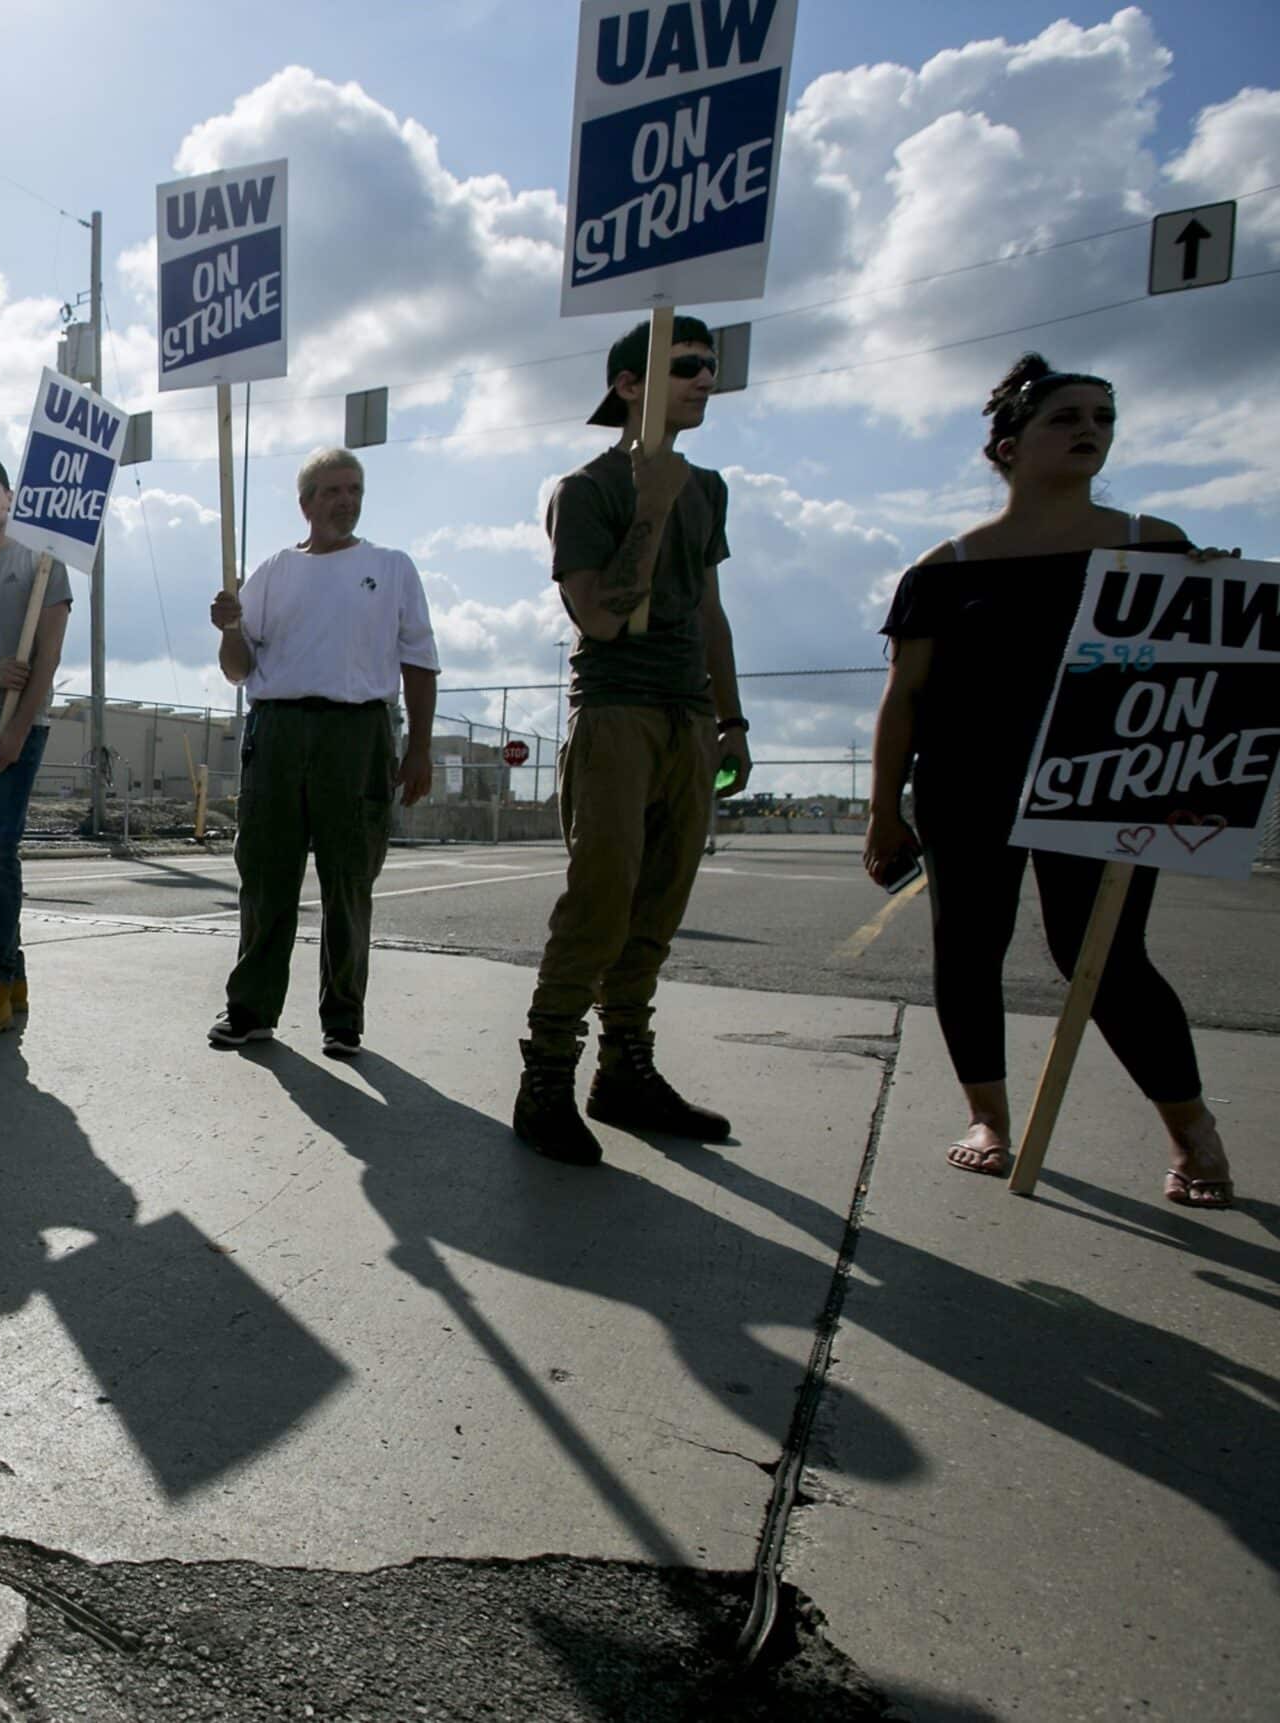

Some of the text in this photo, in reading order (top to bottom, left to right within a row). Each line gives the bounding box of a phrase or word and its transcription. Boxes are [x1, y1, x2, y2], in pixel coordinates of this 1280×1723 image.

[596, 0, 778, 85] UAW
[631, 95, 711, 184] ON
[166, 175, 275, 241] UAW
[575, 137, 772, 279] STRIKE
[193, 244, 239, 303] ON
[163, 271, 280, 368] STRIKE
[44, 381, 120, 451] UAW
[50, 450, 89, 485] ON
[15, 485, 106, 521] STRIKE
[1093, 570, 1280, 652] UAW
[1067, 642, 1155, 673] 598
[1114, 670, 1219, 738] ON
[504, 746, 528, 759] STOP
[1030, 727, 1280, 812] STRIKE
